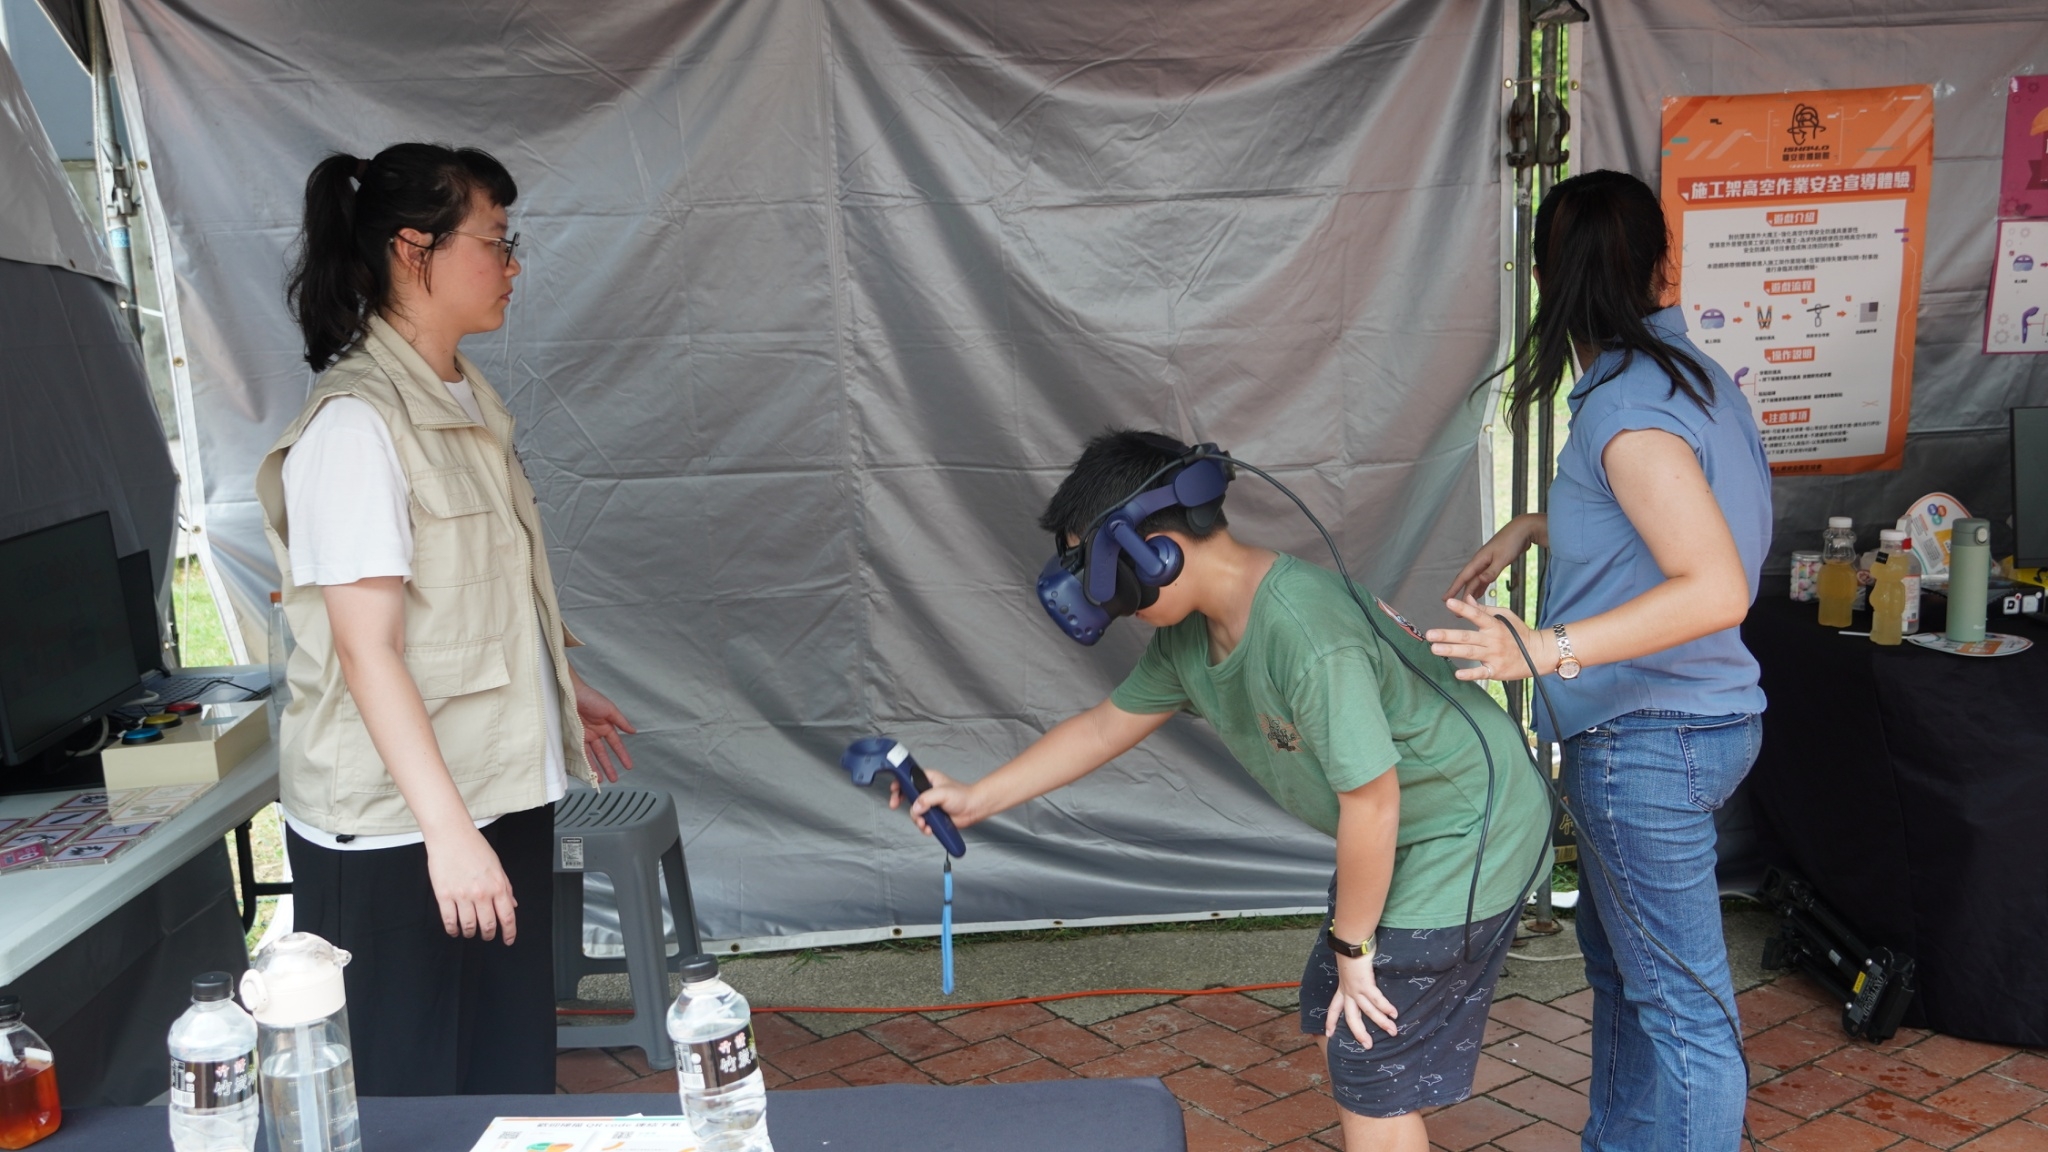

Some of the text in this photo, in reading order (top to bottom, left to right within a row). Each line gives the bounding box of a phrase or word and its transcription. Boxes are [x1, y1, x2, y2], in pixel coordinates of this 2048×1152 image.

[1691, 170, 1911, 200] 施工架高空作業安全宣導體驗
[1773, 211, 1816, 224] 遊戲介紹
[1771, 281, 1813, 293] 遊戲流程
[1772, 349, 1813, 360] 操作說明
[1769, 411, 1808, 423] 注意事項
